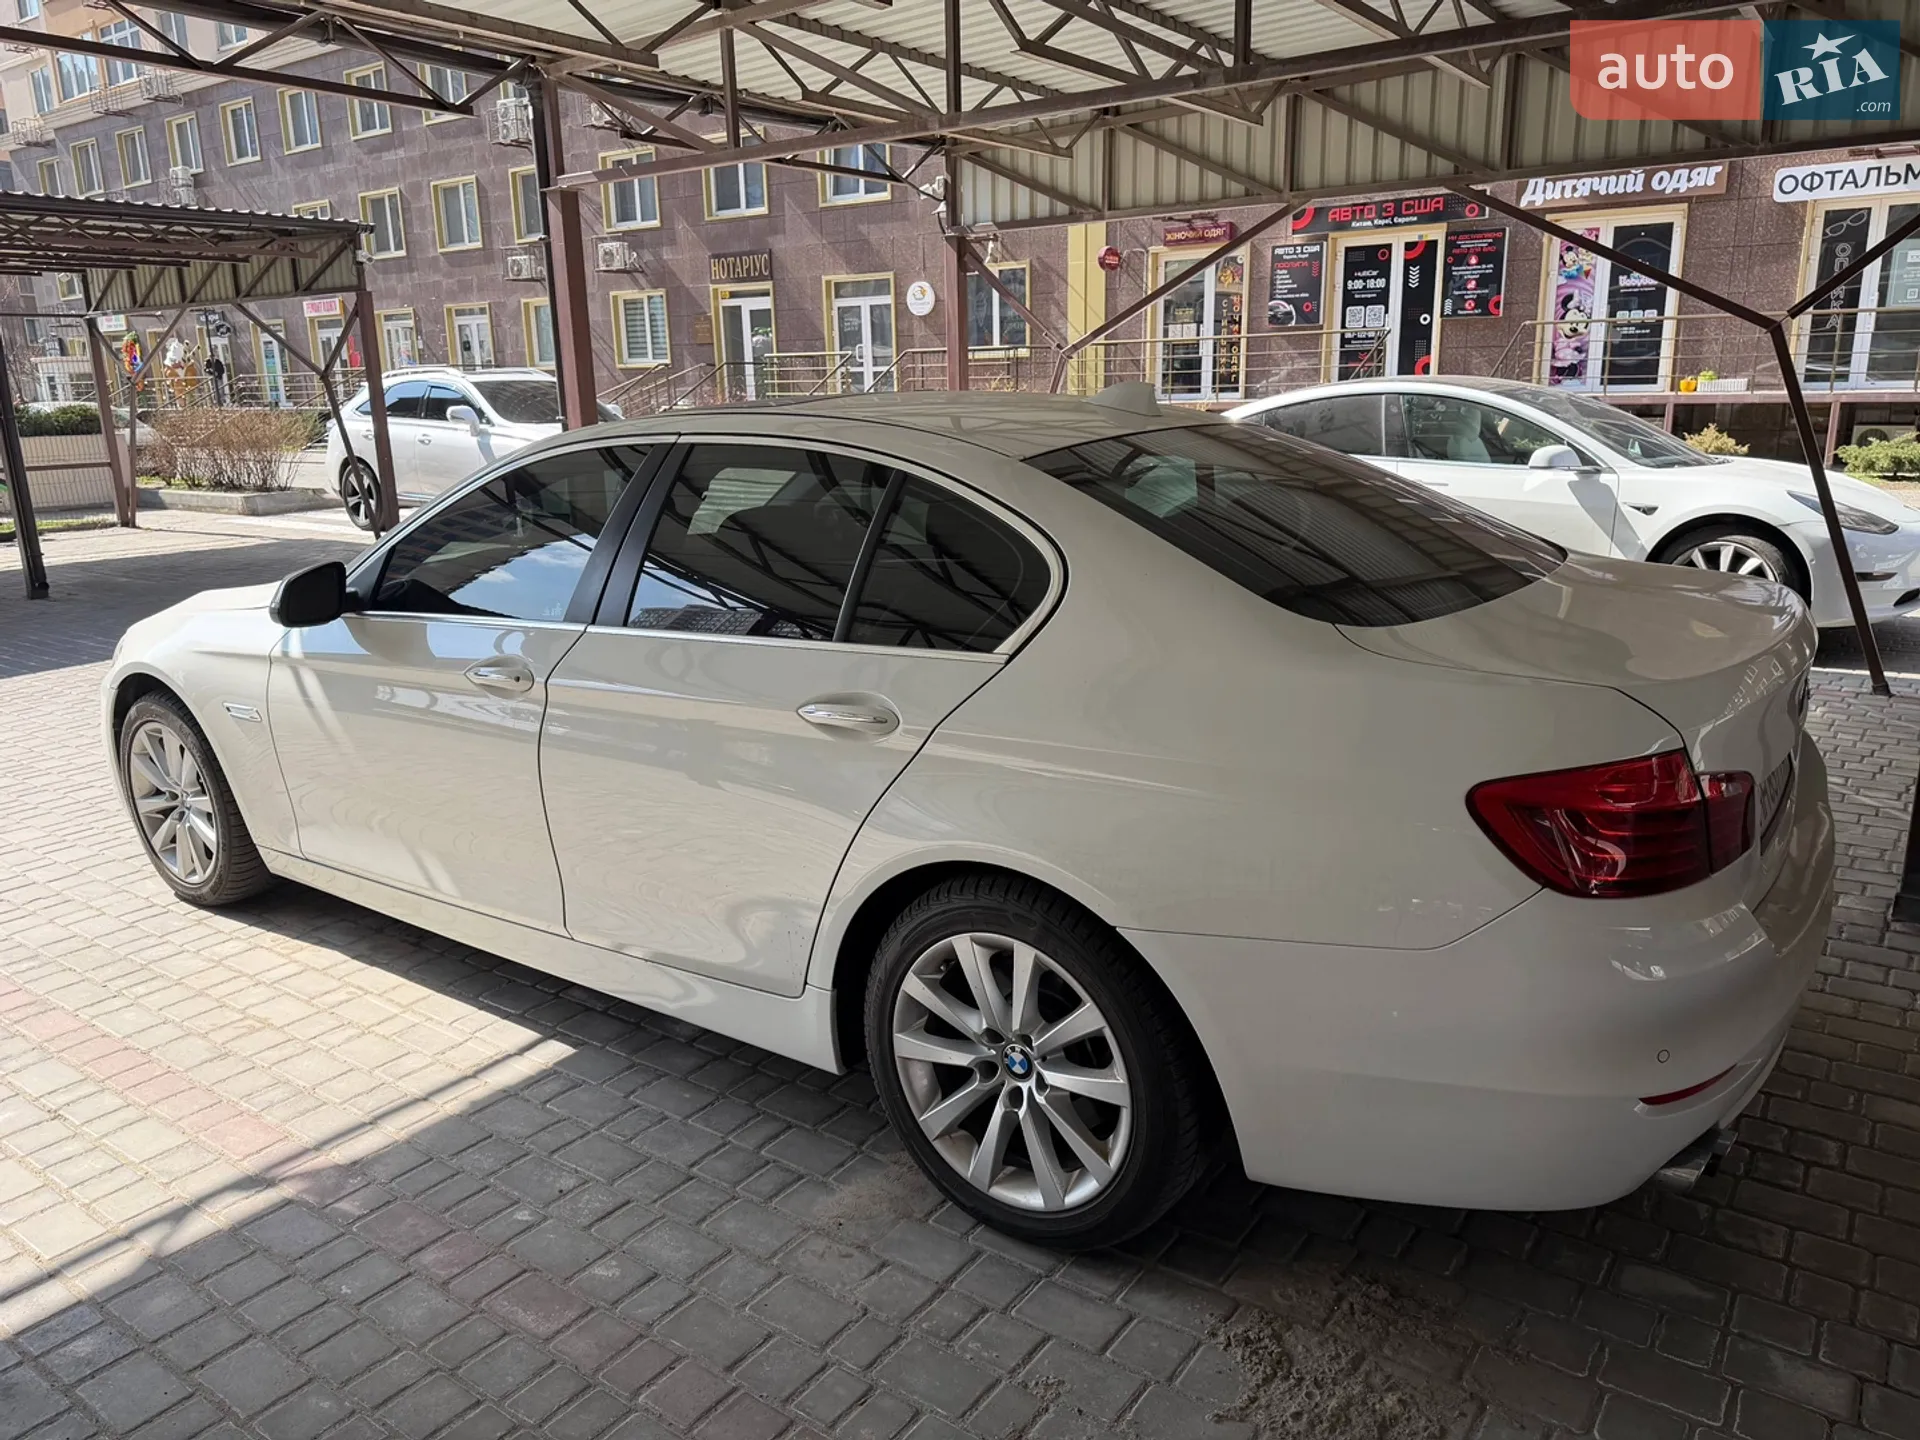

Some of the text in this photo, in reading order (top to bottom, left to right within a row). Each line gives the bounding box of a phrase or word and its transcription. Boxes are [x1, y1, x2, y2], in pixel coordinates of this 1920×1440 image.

[1519, 165, 1723, 207] Дитячий одяг
[1328, 204, 1376, 222] АВТО
[1402, 197, 1445, 215] США
[1204, 227, 1227, 239] ОДЯГ
[1274, 246, 1294, 255] АВТО
[1303, 245, 1320, 253] США
[710, 253, 769, 280] НОТАРІУС
[1826, 243, 1852, 328] ОПИКА
